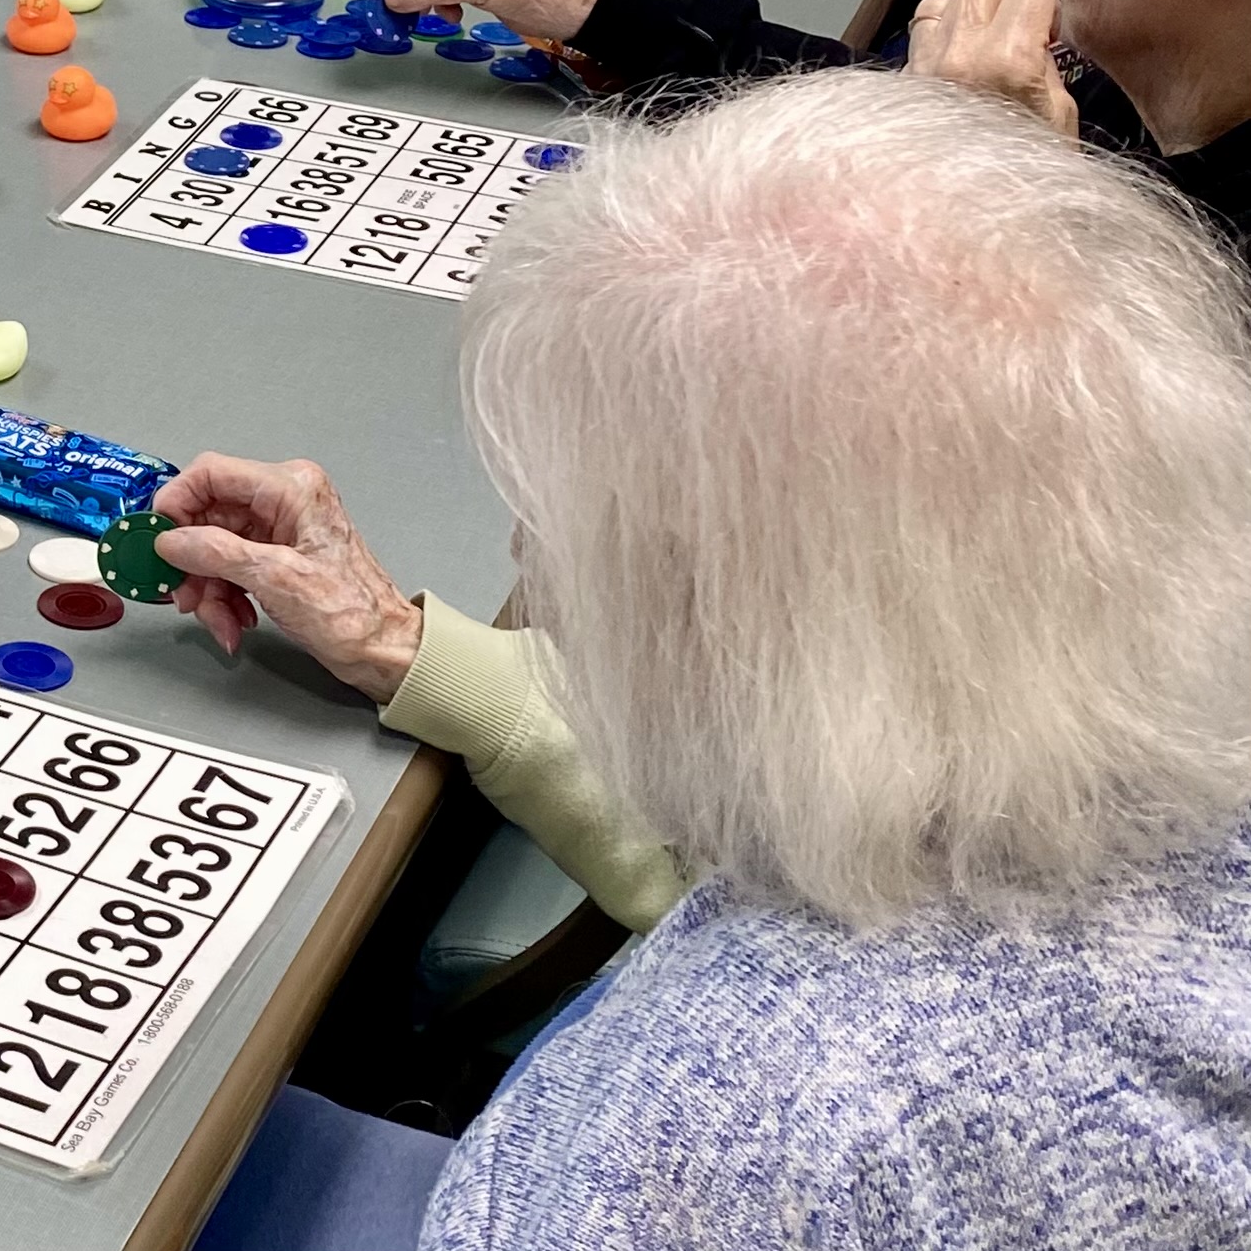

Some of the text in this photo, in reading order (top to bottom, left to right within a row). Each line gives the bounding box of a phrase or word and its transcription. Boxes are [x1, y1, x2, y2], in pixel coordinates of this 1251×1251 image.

[81, 91, 223, 214] B I N G O
[149, 97, 309, 230] 4 30 66
[266, 114, 400, 222] 16 38 51 69
[340, 129, 495, 272] 12 18 50 65
[43, 732, 142, 792] 66
[178, 765, 273, 833] 67
[127, 833, 232, 902] 53
[77, 899, 185, 969] 38
[24, 967, 133, 1035] 18
[61, 1132, 84, 1153] Sea
[75, 1108, 104, 1132] Bay
[94, 1074, 127, 1106] Games
[137, 978, 195, 1046] 1-800-568-0188
